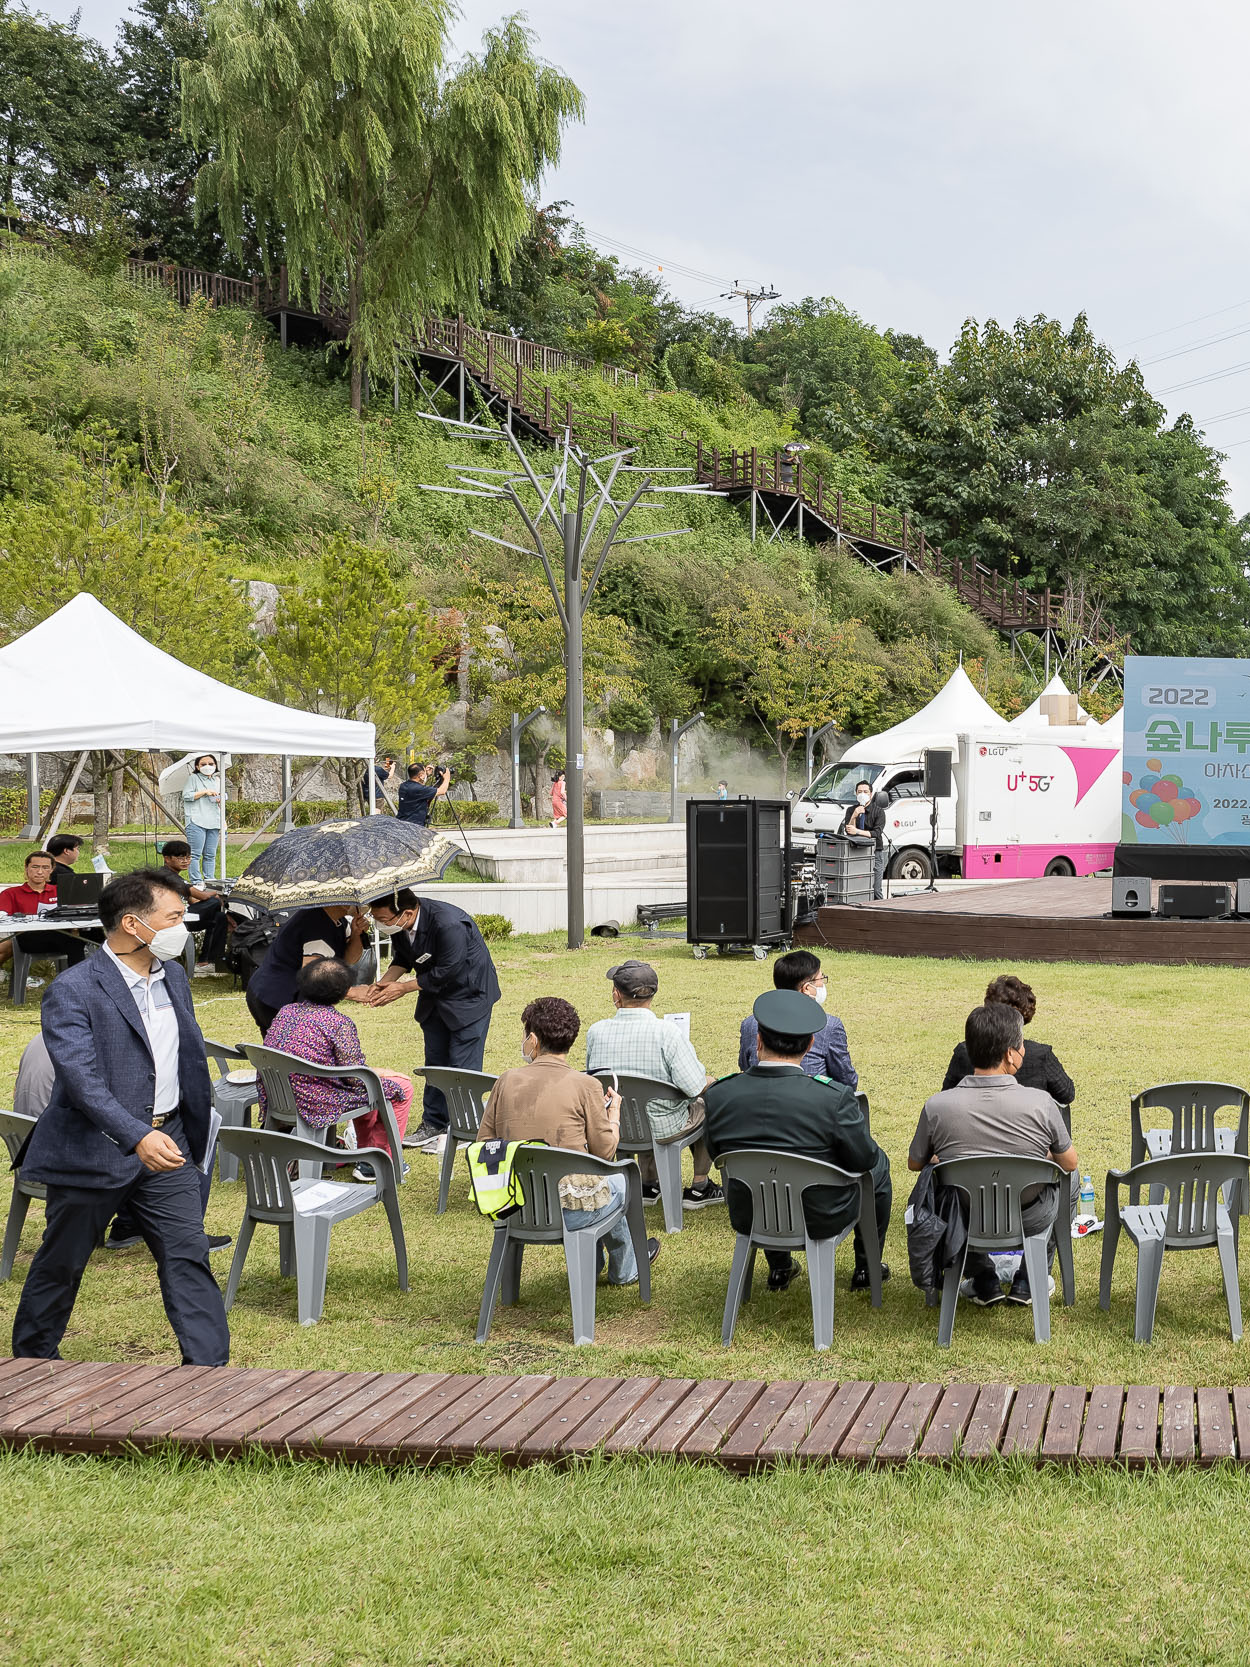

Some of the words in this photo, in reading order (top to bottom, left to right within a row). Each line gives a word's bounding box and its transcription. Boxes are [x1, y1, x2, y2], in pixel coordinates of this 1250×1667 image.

[1148, 687, 1210, 706] 2022
[1007, 771, 1027, 792] U+
[1029, 775, 1051, 792] 5G
